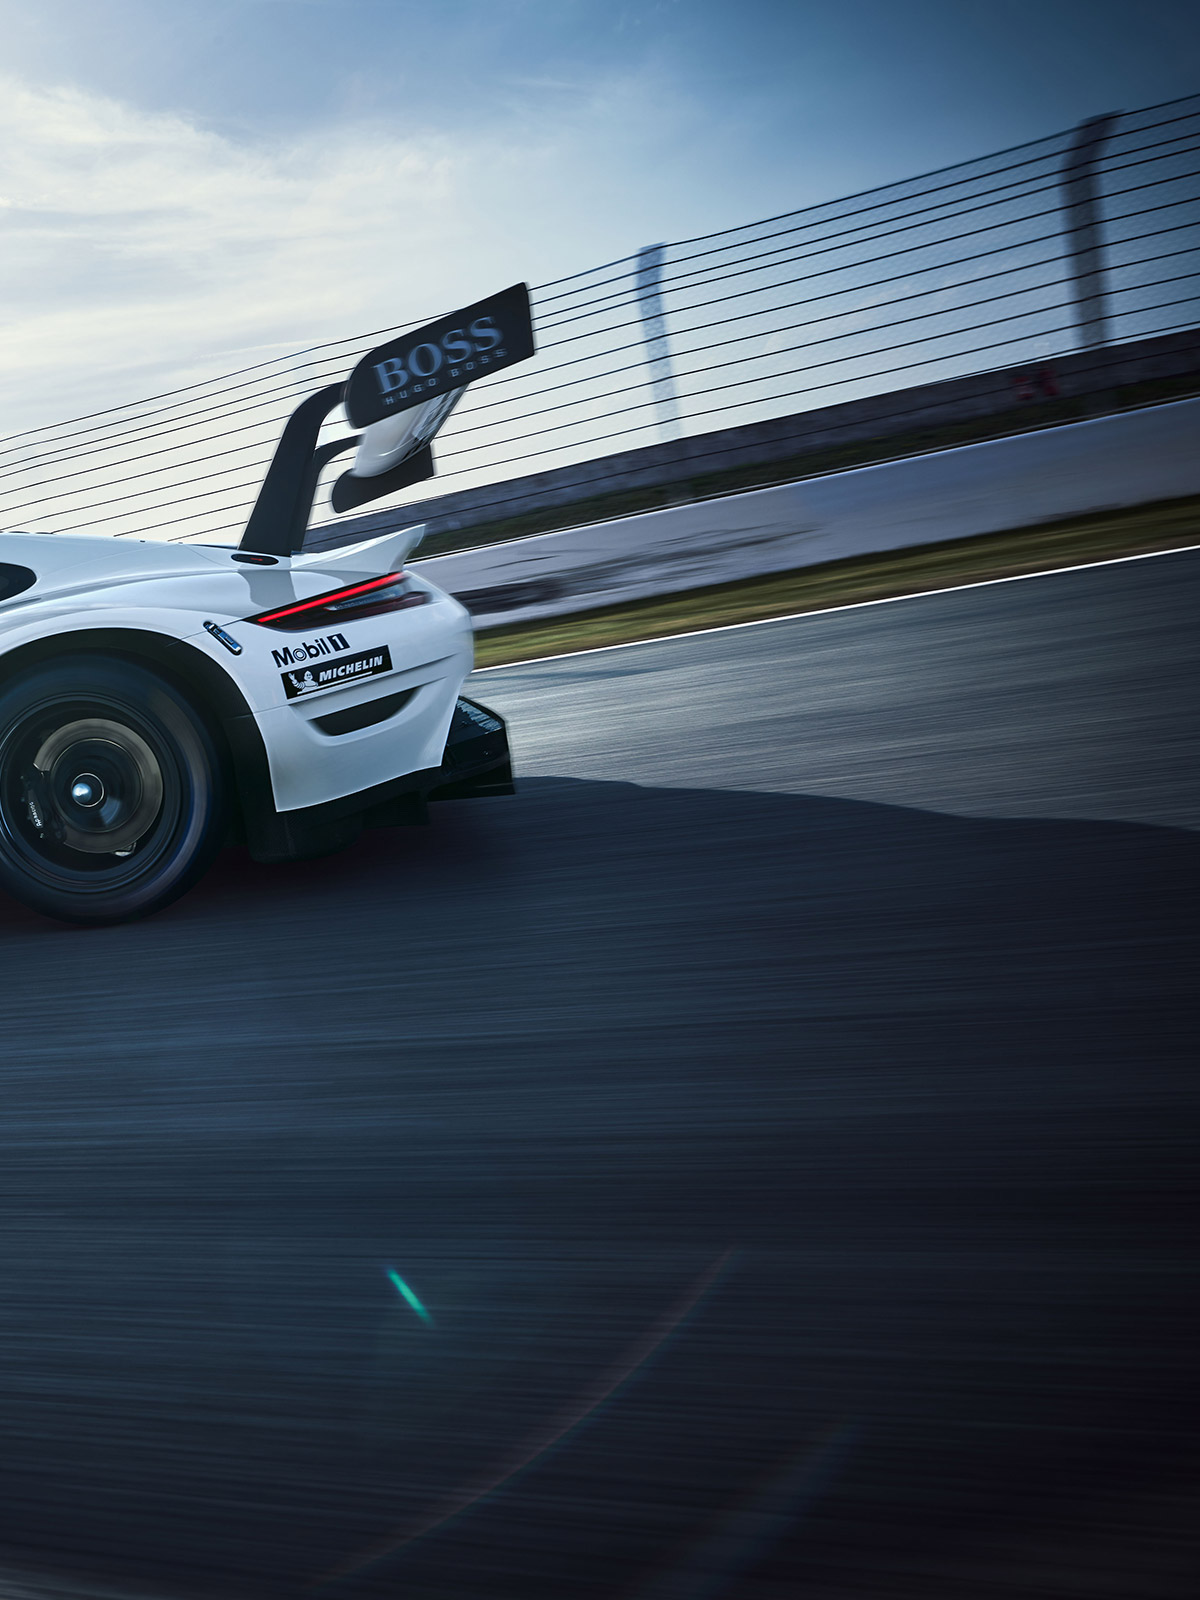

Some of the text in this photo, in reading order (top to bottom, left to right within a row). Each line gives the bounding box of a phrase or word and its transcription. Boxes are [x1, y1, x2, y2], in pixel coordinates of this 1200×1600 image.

[372, 316, 503, 394] BOSS
[385, 348, 506, 405] HUGO BOSS
[271, 637, 331, 668] Mobil
[319, 655, 383, 682] MICHELIN
